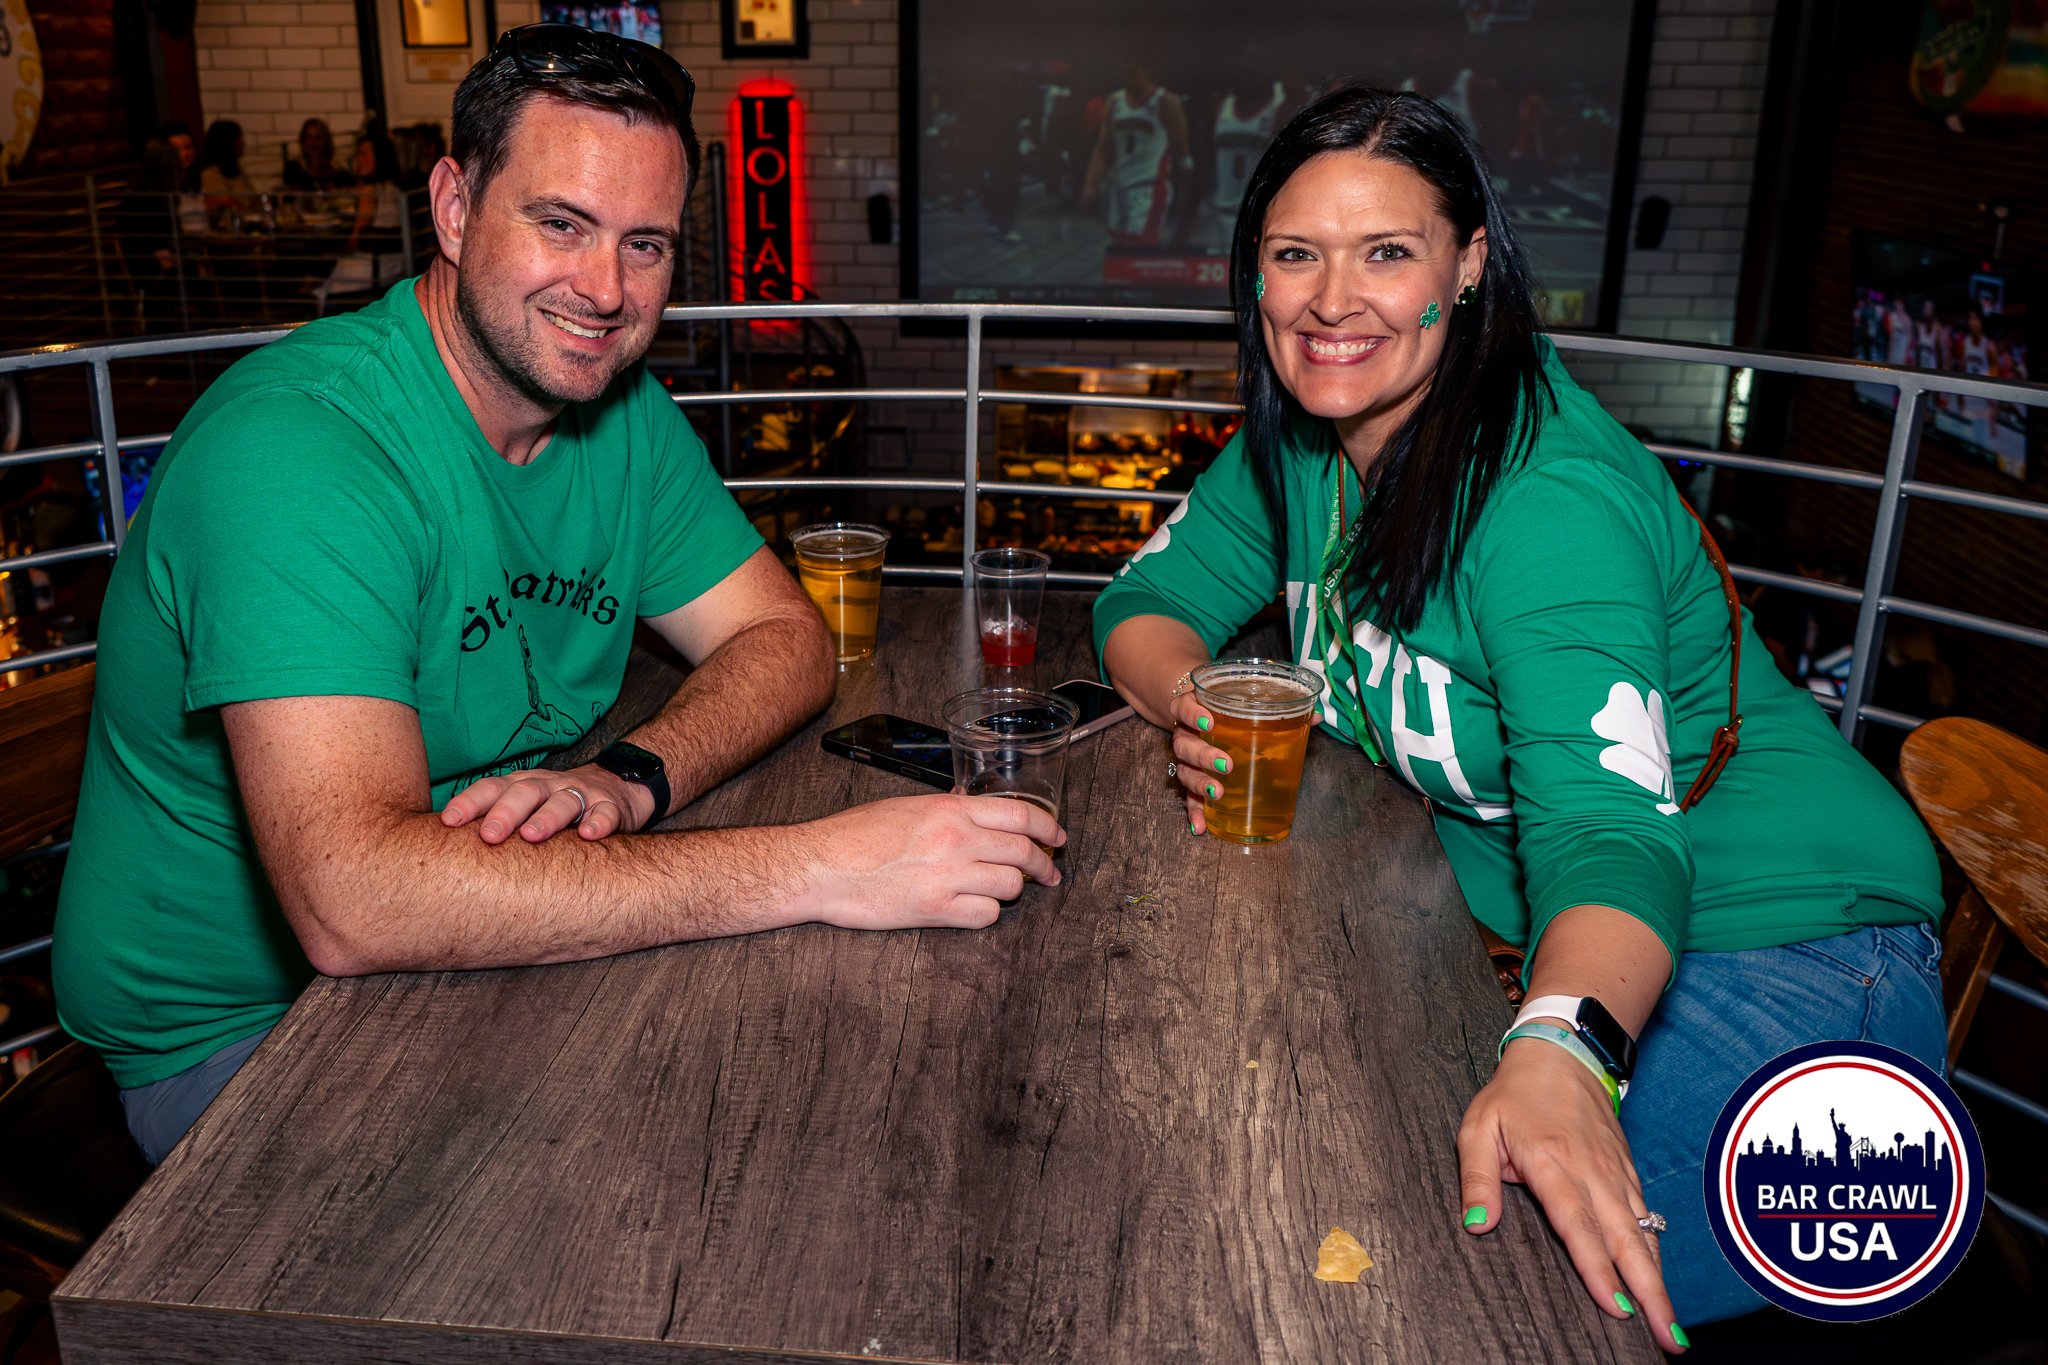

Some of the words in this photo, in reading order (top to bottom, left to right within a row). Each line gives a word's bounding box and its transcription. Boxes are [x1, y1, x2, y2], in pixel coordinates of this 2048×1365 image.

[747, 100, 787, 302] LOLAS
[1197, 263, 1225, 283] 20
[1323, 567, 1342, 599] USA
